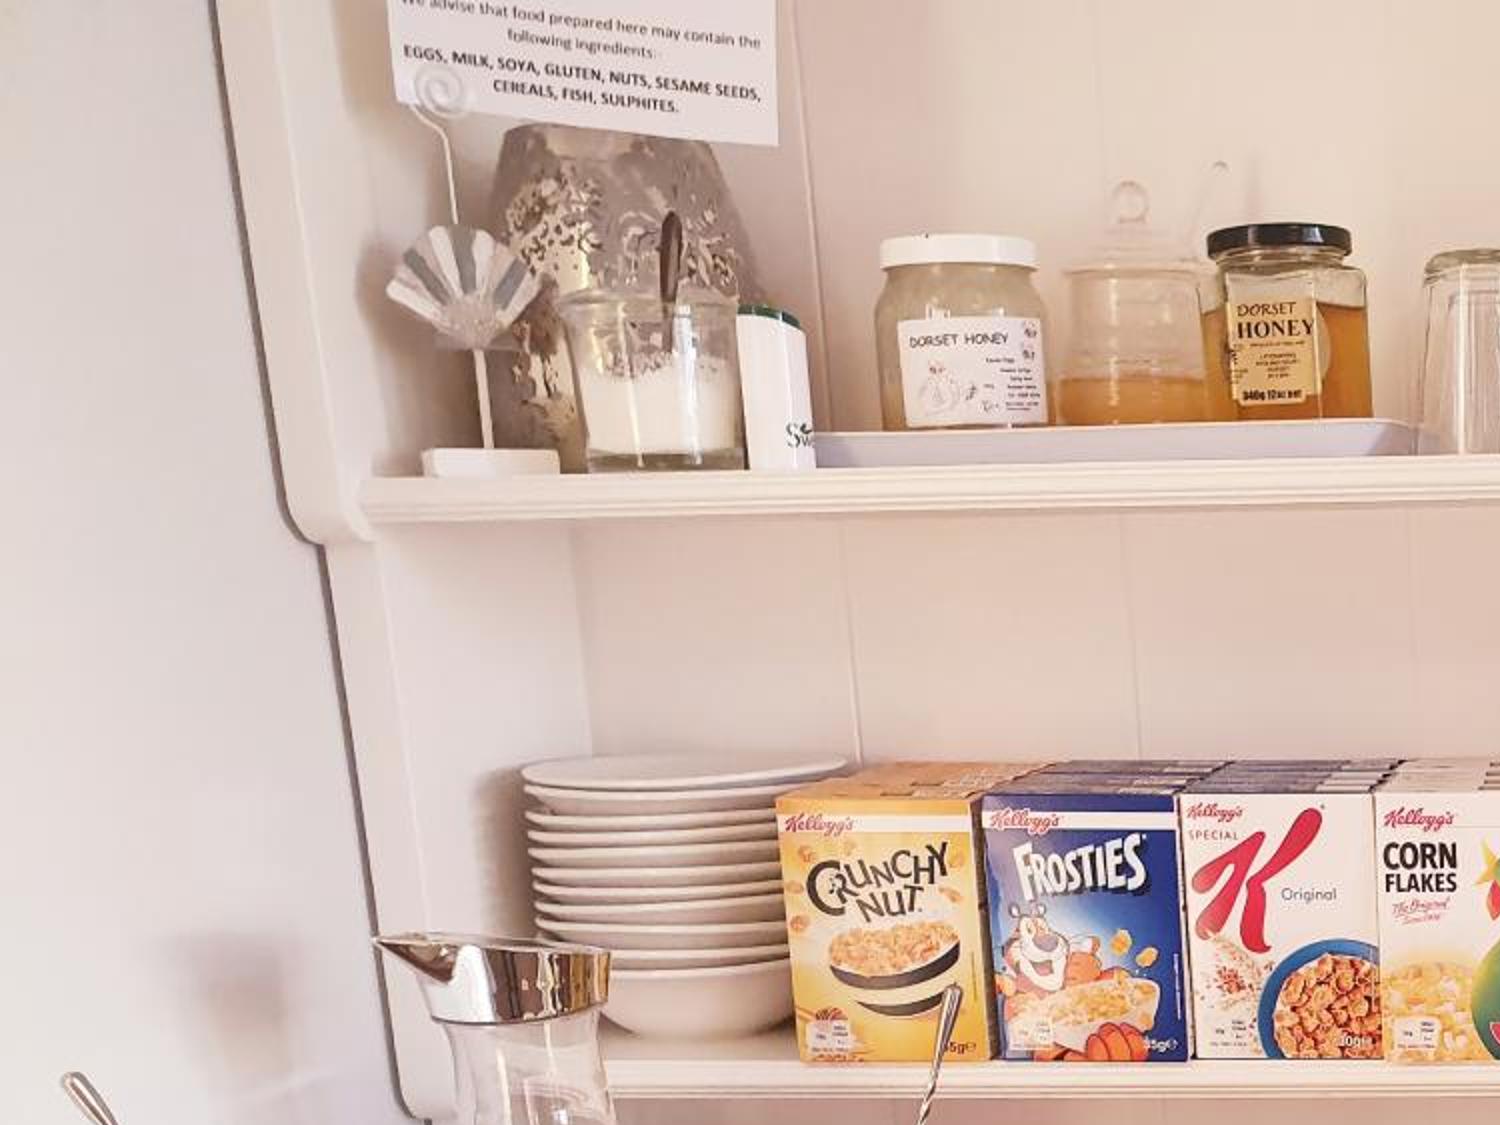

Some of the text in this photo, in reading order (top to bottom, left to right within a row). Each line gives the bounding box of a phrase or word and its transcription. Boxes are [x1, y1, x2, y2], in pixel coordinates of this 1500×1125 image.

[479, 2, 508, 18] that
[513, 6, 545, 23] food
[549, 14, 613, 31] prepared
[616, 19, 648, 35] here
[651, 26, 681, 41] may
[684, 30, 735, 46] contain
[739, 34, 761, 49] the
[507, 28, 573, 51] following
[403, 44, 761, 103] EGGS, MILK, SOYA, GLUTEN, NUTS, SESAME SEEDS,
[493, 79, 680, 113] CEREALS, FISH, SULPHITES.
[1236, 301, 1297, 317] DORSET
[909, 331, 1009, 348] DORSET HONEY
[1237, 319, 1315, 339] HONEY
[988, 806, 1064, 834] Kellogg's
[1187, 801, 1243, 823] Kellogg's
[1383, 806, 1456, 832] Kellogg's
[785, 813, 857, 837] Kellogg's
[1188, 829, 1239, 841] SPECIAL
[1012, 832, 1149, 901] FROSTIES
[1383, 841, 1458, 870] CORN
[806, 840, 949, 917] CRUNCHY
[1384, 872, 1458, 893] FLAKES
[857, 884, 924, 923] NUT
[1281, 887, 1338, 903] Original
